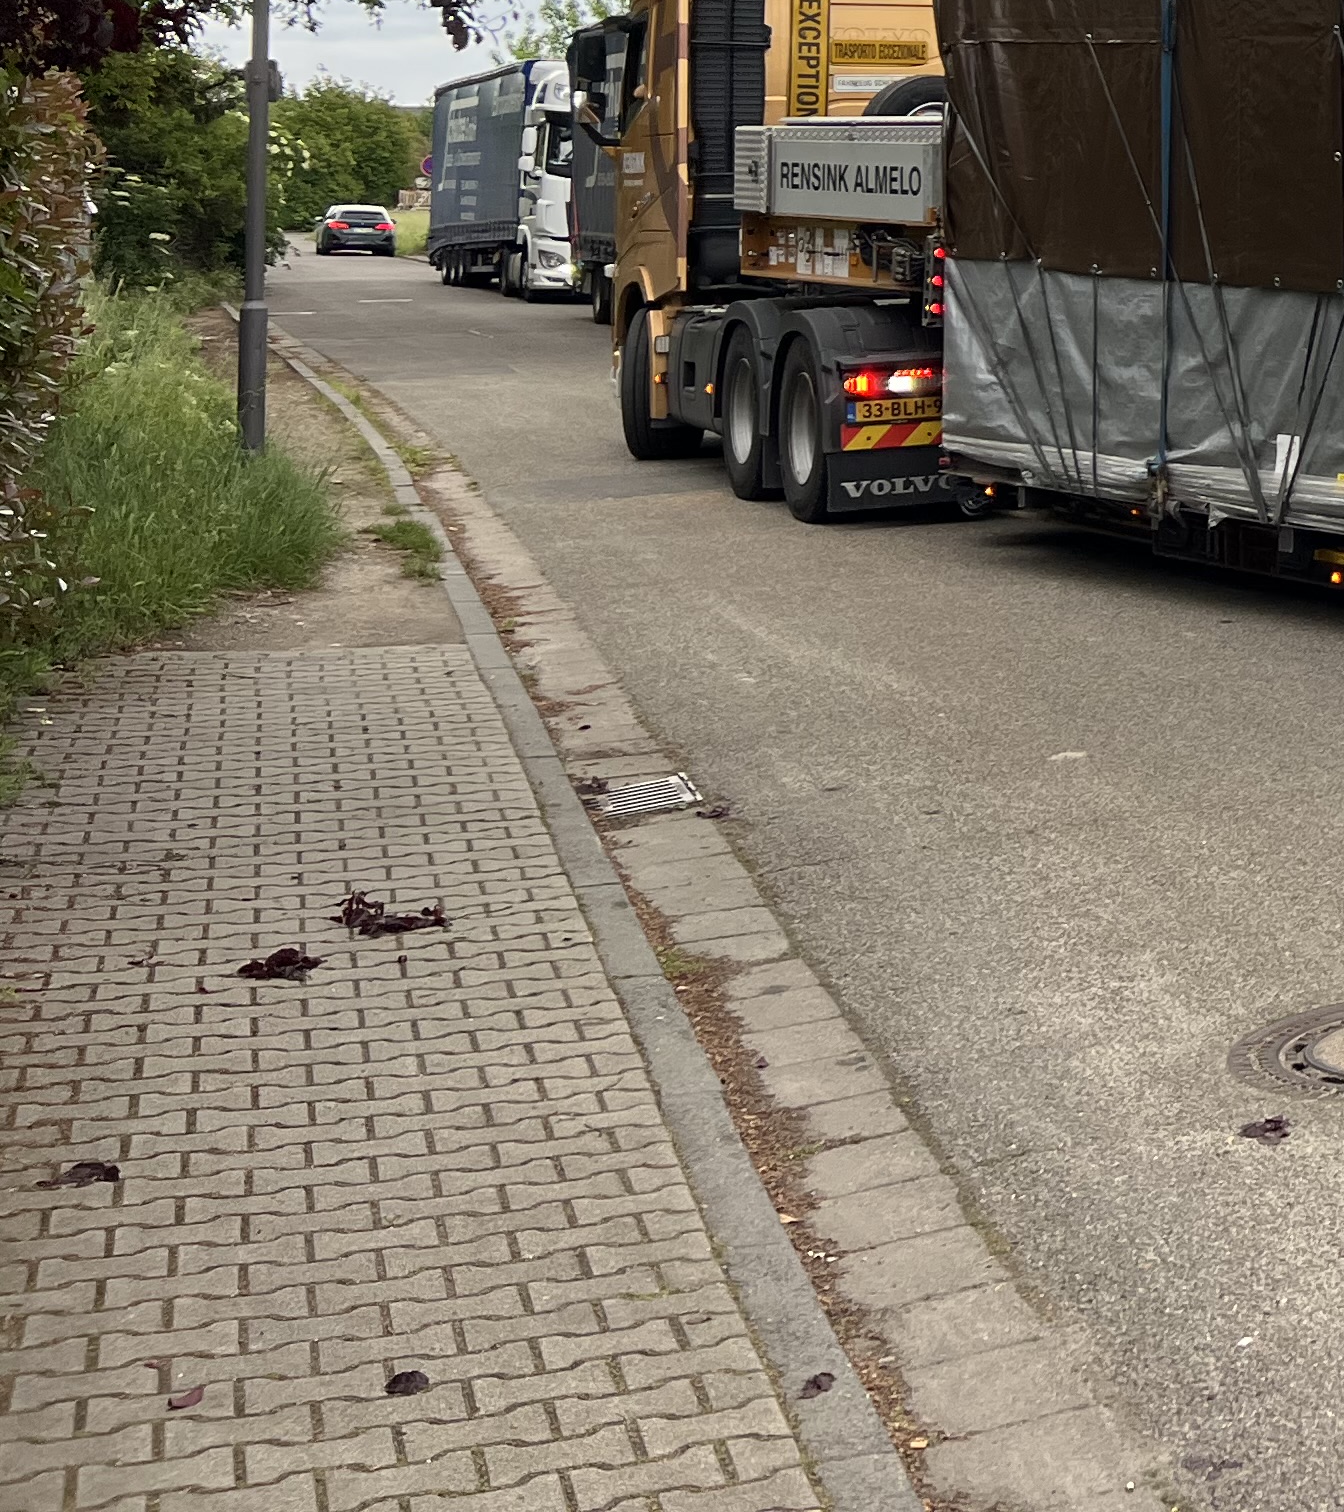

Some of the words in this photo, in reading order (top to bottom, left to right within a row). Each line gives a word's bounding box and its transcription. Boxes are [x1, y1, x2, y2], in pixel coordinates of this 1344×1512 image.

[834, 42, 877, 60] TRASPORTO
[780, 161, 849, 193] RENSINK
[853, 164, 922, 197] ALMELO
[862, 399, 942, 419] 33-BLH-9
